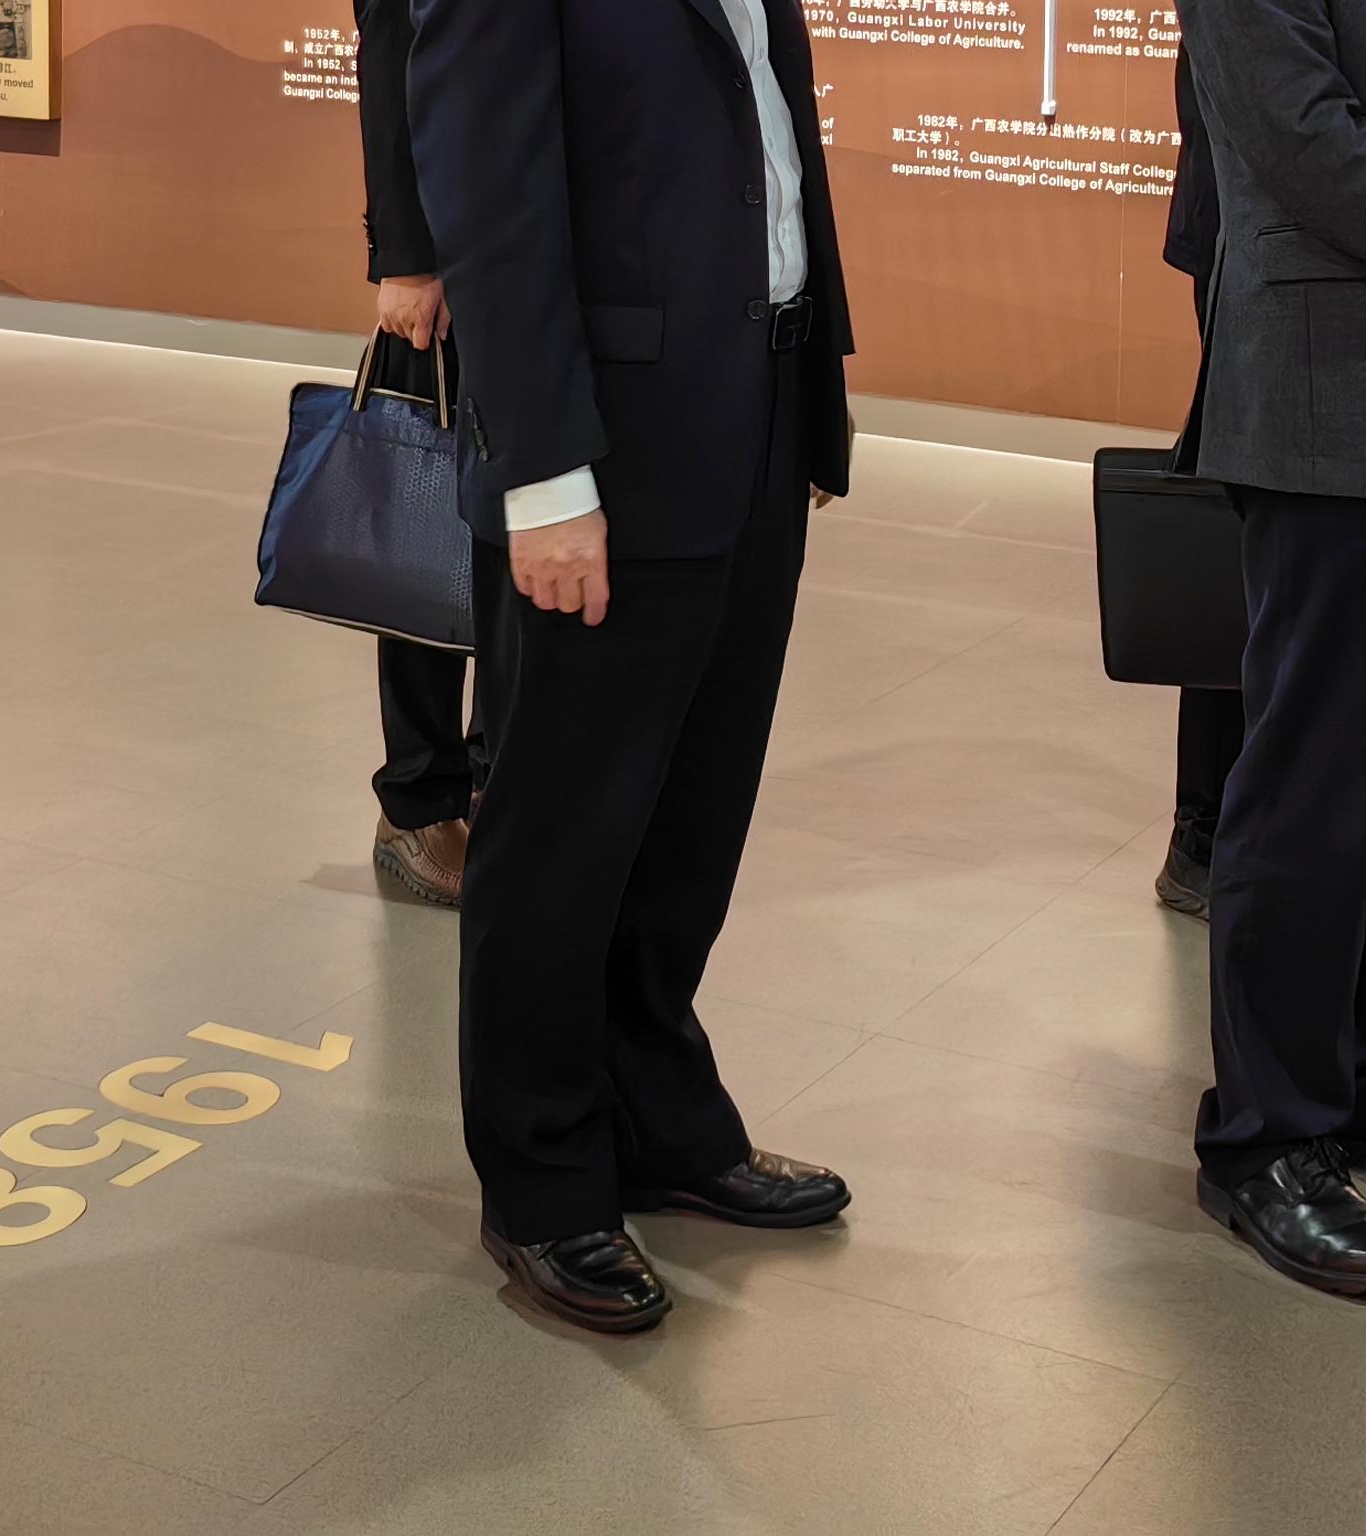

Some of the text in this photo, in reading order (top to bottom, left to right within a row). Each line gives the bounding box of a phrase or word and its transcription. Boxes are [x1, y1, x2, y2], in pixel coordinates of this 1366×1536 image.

[891, 163, 951, 177] separated
[952, 166, 982, 180] from
[984, 168, 1036, 186] Guangxi
[1038, 173, 1087, 191] College
[1089, 178, 1103, 190] of
[916, 146, 928, 159] In
[969, 151, 1021, 169] Guangxi
[1022, 155, 1097, 172] Agricultural
[1099, 161, 1131, 175] Staff
[1132, 164, 1177, 181] Colleg
